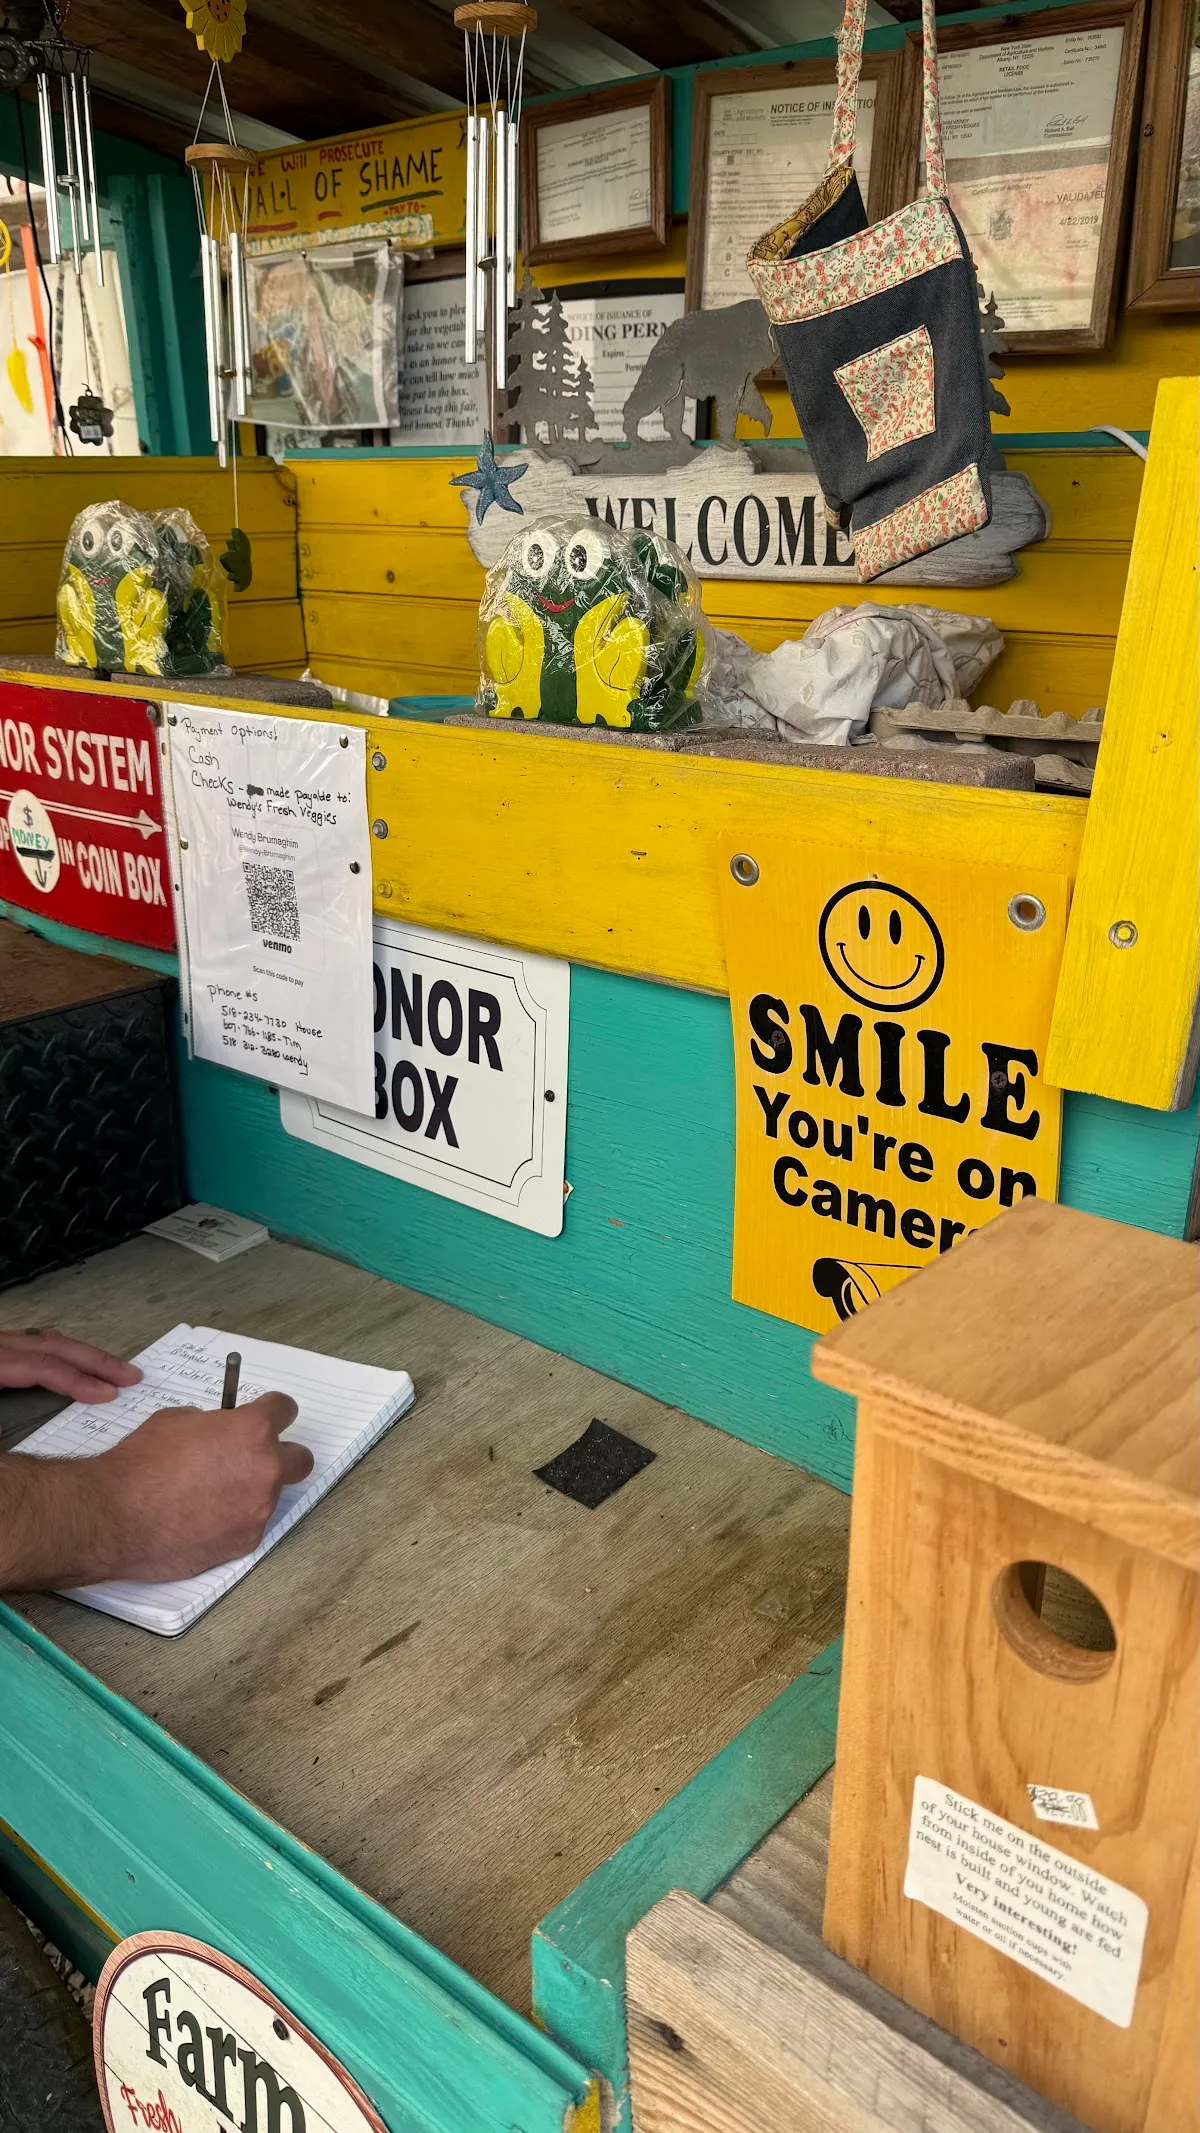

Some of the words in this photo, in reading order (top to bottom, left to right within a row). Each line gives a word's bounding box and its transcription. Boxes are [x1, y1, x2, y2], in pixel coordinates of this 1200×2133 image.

[770, 101, 805, 115] NOTICE
[807, 101, 821, 113] OF
[315, 168, 343, 202] OF
[360, 148, 443, 198] SHAME
[319, 140, 384, 165] PROSECUTE
[1057, 190, 1106, 202] VALIDATED
[1059, 215, 1099, 226] 4/22/2019
[596, 311, 605, 319] OF
[606, 310, 641, 320] ISSUANCE
[642, 309, 653, 318] OF
[180, 717, 223, 743] Payment
[43, 725, 153, 796] SYSTEM
[188, 745, 220, 770] Cash
[227, 797, 262, 819] Wendy's
[266, 800, 297, 818] Fresh
[300, 806, 337, 827] Veggies
[266, 787, 290, 799] made
[12, 827, 50, 850] MONEY
[231, 827, 257, 844] Wendy
[257, 829, 299, 849] Brumaghim
[57, 837, 76, 867] IN
[77, 840, 124, 897] COIN
[123, 851, 168, 908] BOX
[262, 938, 293, 954] venmo
[252, 964, 266, 976] Scan
[266, 967, 276, 978] this
[275, 971, 289, 982] code
[288, 975, 295, 984] to
[294, 978, 304, 988] pay
[295, 1020, 323, 1038] House
[373, 961, 504, 1072] NOR
[748, 992, 1041, 1141] SMILE
[753, 1085, 935, 1183] You're
[957, 1158, 1037, 1207] on
[773, 1155, 983, 1254] Camer
[921, 1800, 937, 1814] of
[938, 1810, 968, 1833] your
[971, 1827, 1011, 1858] house
[1081, 1889, 1128, 1927] Watch
[945, 1793, 979, 1823] Stick
[983, 1819, 1003, 1835] me
[1007, 1832, 1025, 1848] on
[1029, 1843, 1051, 1863] the
[1054, 1858, 1108, 1896] outside
[915, 1830, 942, 1853] nest
[946, 1845, 957, 1860] is
[961, 1856, 992, 1881] built
[995, 1876, 1020, 1898] and
[1024, 1892, 1067, 1929] young
[1072, 1923, 1094, 1942] are
[921, 1815, 953, 1841] from
[956, 1831, 997, 1866] inside
[1000, 1861, 1017, 1878] of
[1017, 1872, 1044, 1896] you
[1049, 1888, 1088, 1920] home
[1092, 1913, 1125, 1942] how
[952, 1891, 989, 1919] Moisten
[991, 1916, 1024, 1941] suction
[1026, 1938, 1048, 1957] cups
[1051, 1951, 1073, 1972] with
[955, 1872, 989, 1903] Very
[993, 1897, 1078, 1955] interesting!
[955, 1907, 980, 1927] water
[982, 1924, 993, 1934] or
[994, 1931, 1006, 1945] oil
[1008, 1940, 1017, 1951] if
[142, 1977, 306, 2133] Farm
[121, 2083, 182, 2133] Fresh
